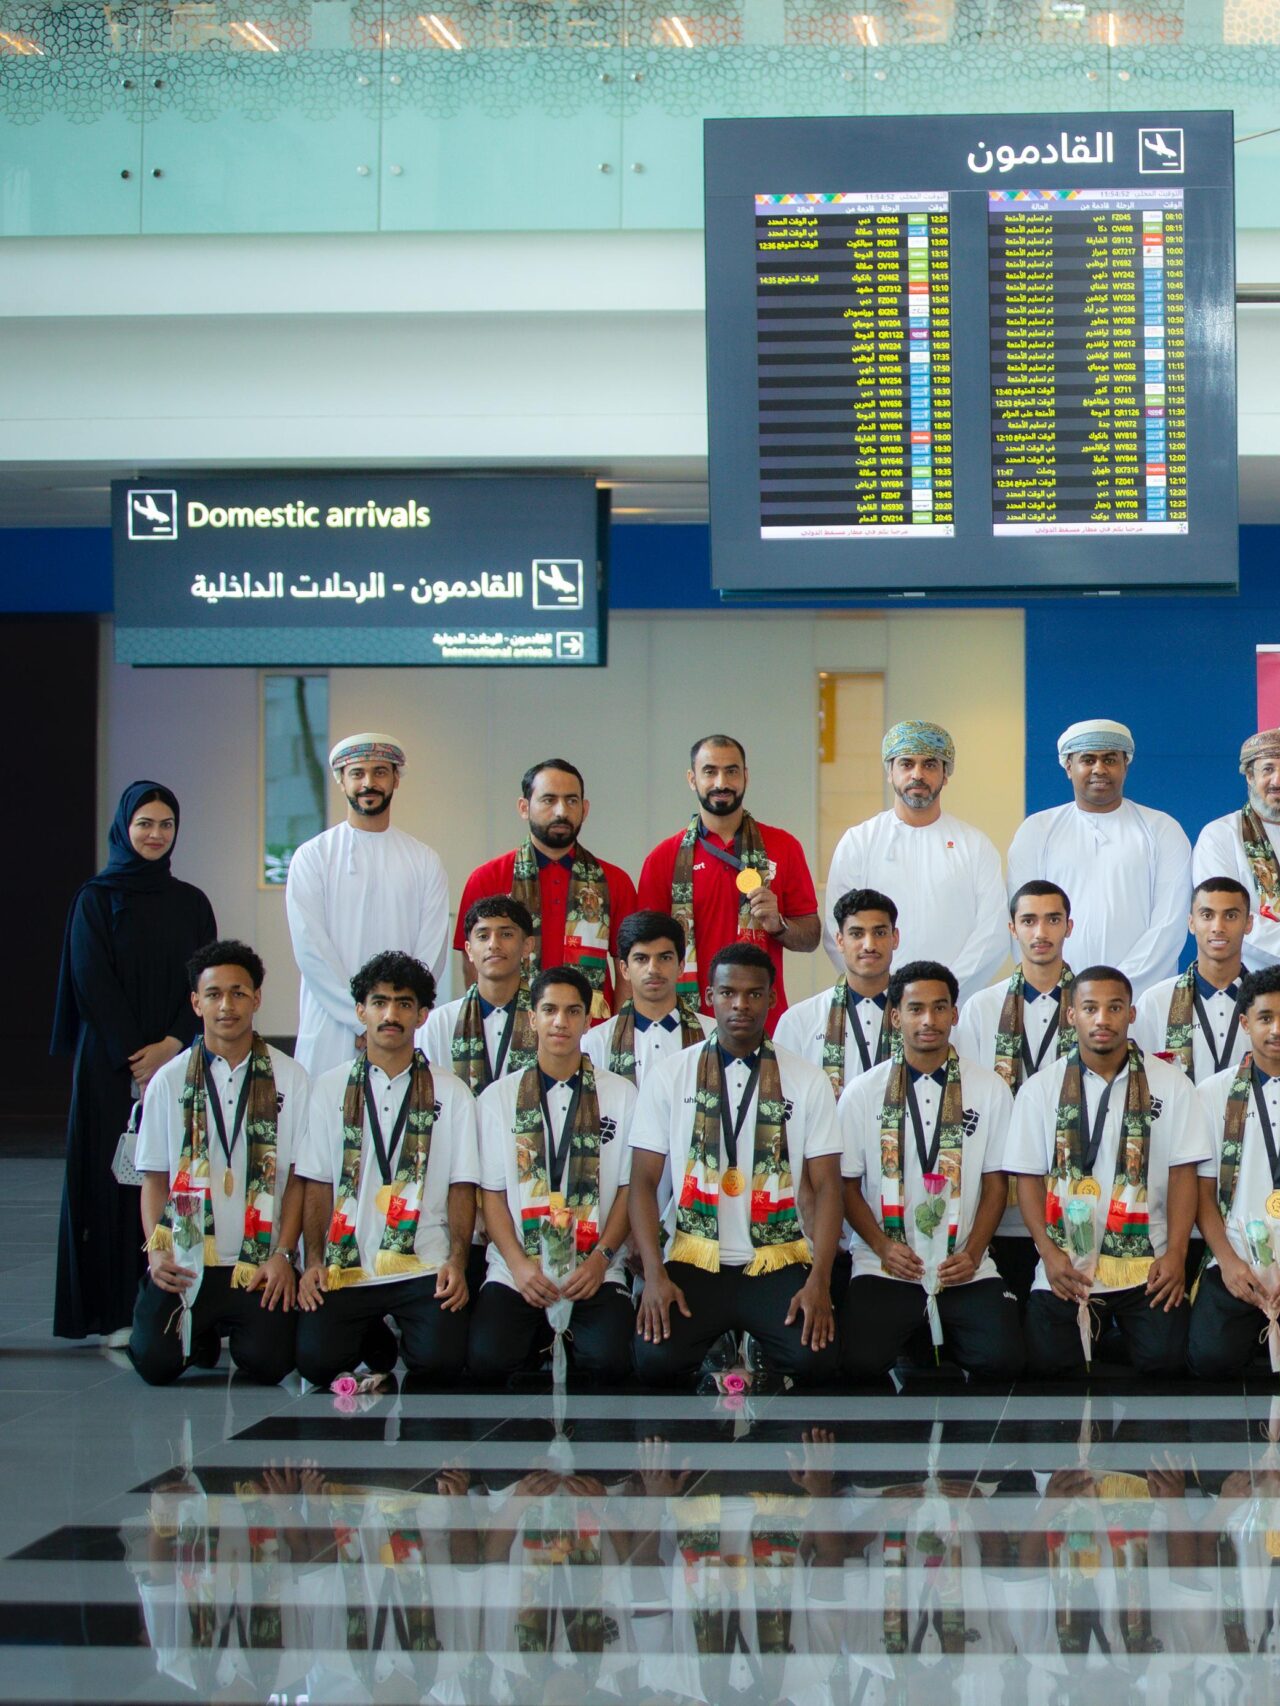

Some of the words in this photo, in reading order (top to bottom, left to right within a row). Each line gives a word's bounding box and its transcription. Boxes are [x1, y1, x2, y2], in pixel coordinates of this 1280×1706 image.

[967, 131, 1113, 174] القادمون
[931, 215, 948, 223] 12:25
[931, 260, 948, 269] 14:05
[1169, 408, 1184, 416] 11:30
[934, 422, 950, 430] 18:50
[1169, 454, 1185, 462] 12:00
[188, 501, 319, 527] Domestic
[326, 500, 430, 527] arrivals
[190, 572, 284, 604] الداخلية
[290, 572, 385, 604] الرحلات
[411, 572, 522, 604] القادمون
